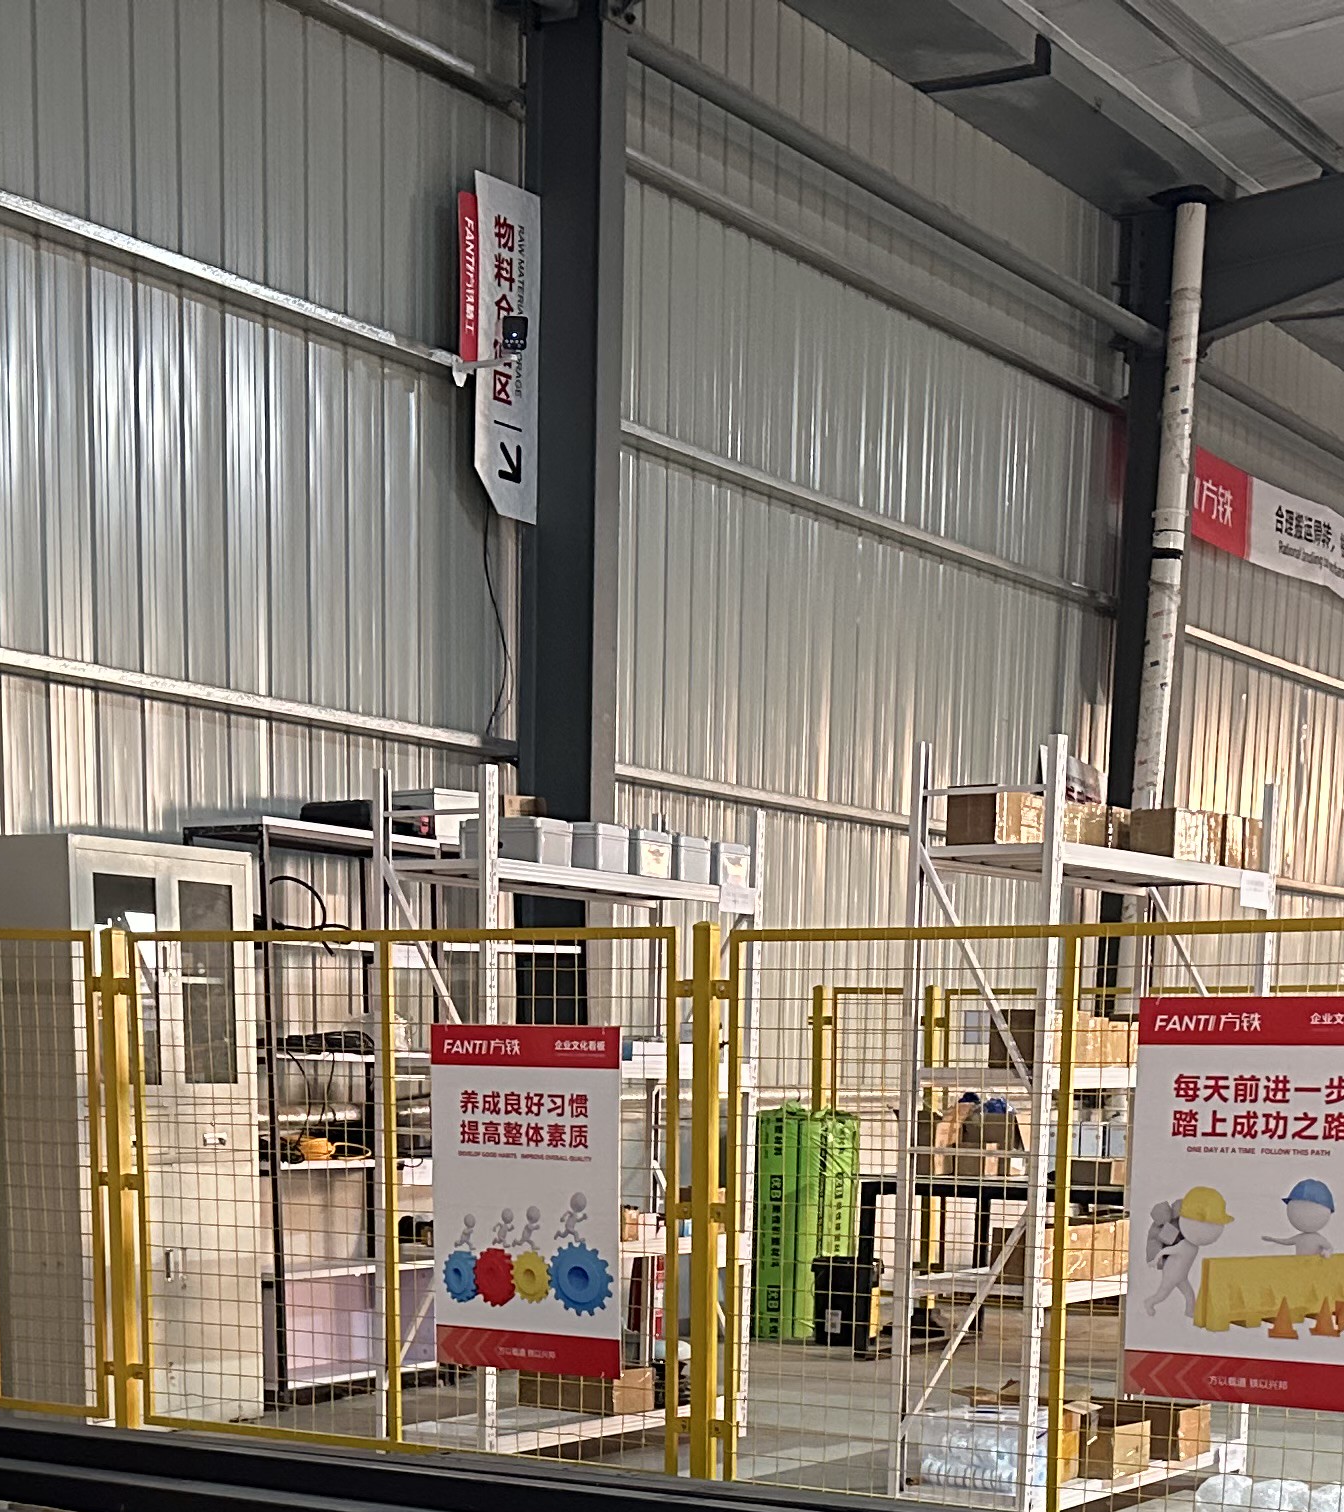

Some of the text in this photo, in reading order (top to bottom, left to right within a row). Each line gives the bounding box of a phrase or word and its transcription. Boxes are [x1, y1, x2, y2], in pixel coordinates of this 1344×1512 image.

[517, 259, 526, 316] MATERIA
[1219, 1012, 1261, 1032] 方铁
[489, 1038, 521, 1055] 方铁
[460, 1090, 588, 1118] 养成良好习惯
[460, 1120, 588, 1149] 提高整体素质
